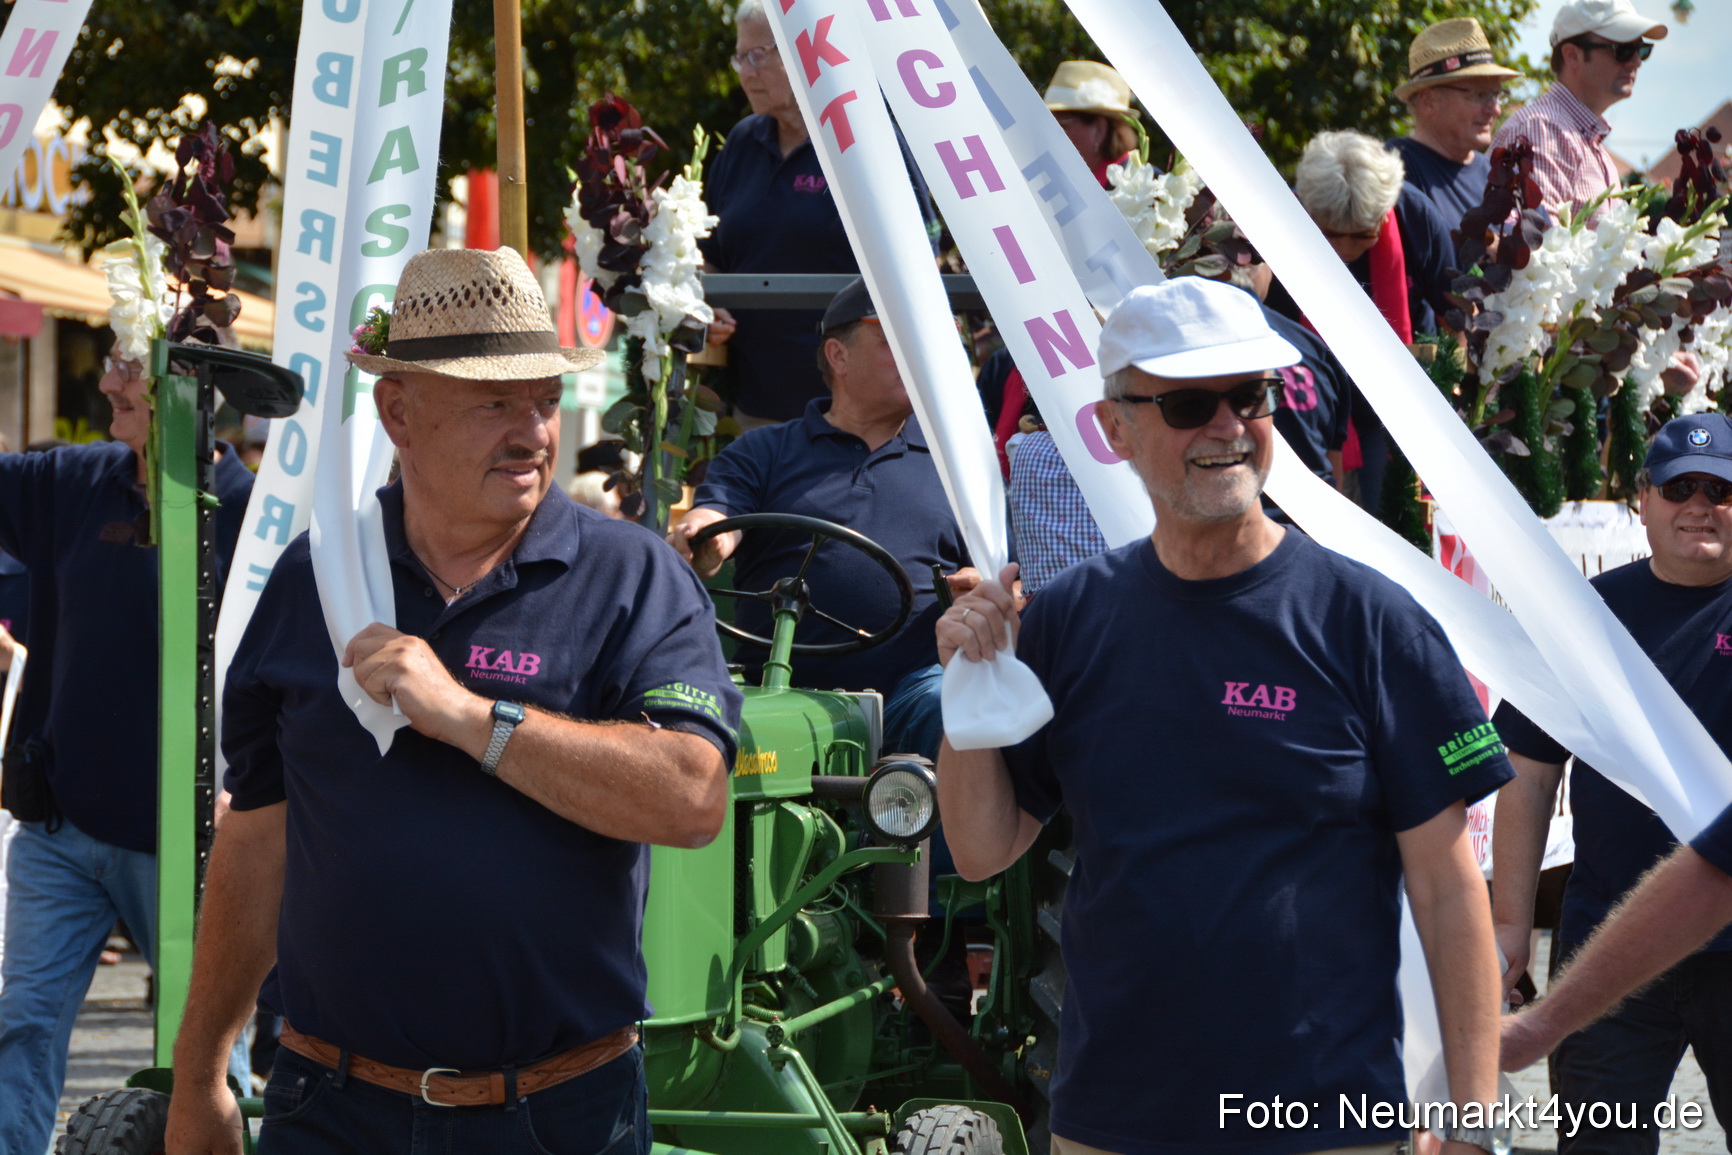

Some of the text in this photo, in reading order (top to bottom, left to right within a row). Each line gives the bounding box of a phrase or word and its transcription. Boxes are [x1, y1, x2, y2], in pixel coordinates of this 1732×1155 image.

[779, 0, 858, 154] KT
[465, 645, 541, 676] KAB
[470, 669, 527, 685] Neumarkt
[1221, 681, 1297, 711] KAB
[1227, 706, 1286, 721] Neumarkt
[1448, 749, 1493, 776] Kirchengasse
